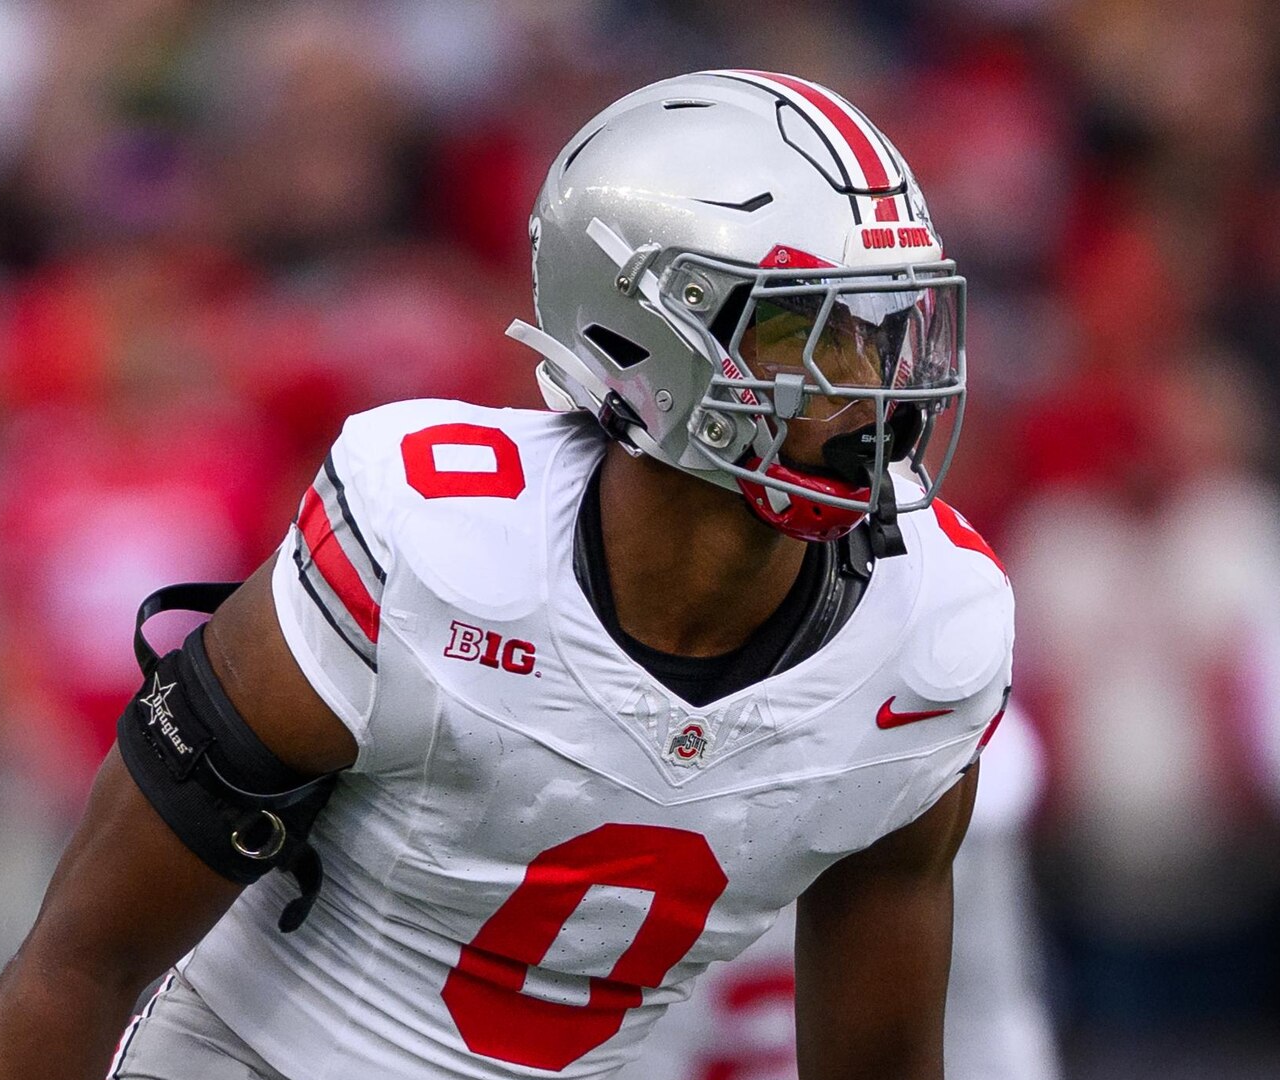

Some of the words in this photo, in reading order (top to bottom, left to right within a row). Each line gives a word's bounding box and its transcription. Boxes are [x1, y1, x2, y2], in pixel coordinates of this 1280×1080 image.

[861, 228, 895, 249] OHIO
[897, 227, 933, 248] STATE
[400, 423, 526, 500] 0
[152, 692, 189, 755] Douglas
[440, 823, 729, 1072] 0
